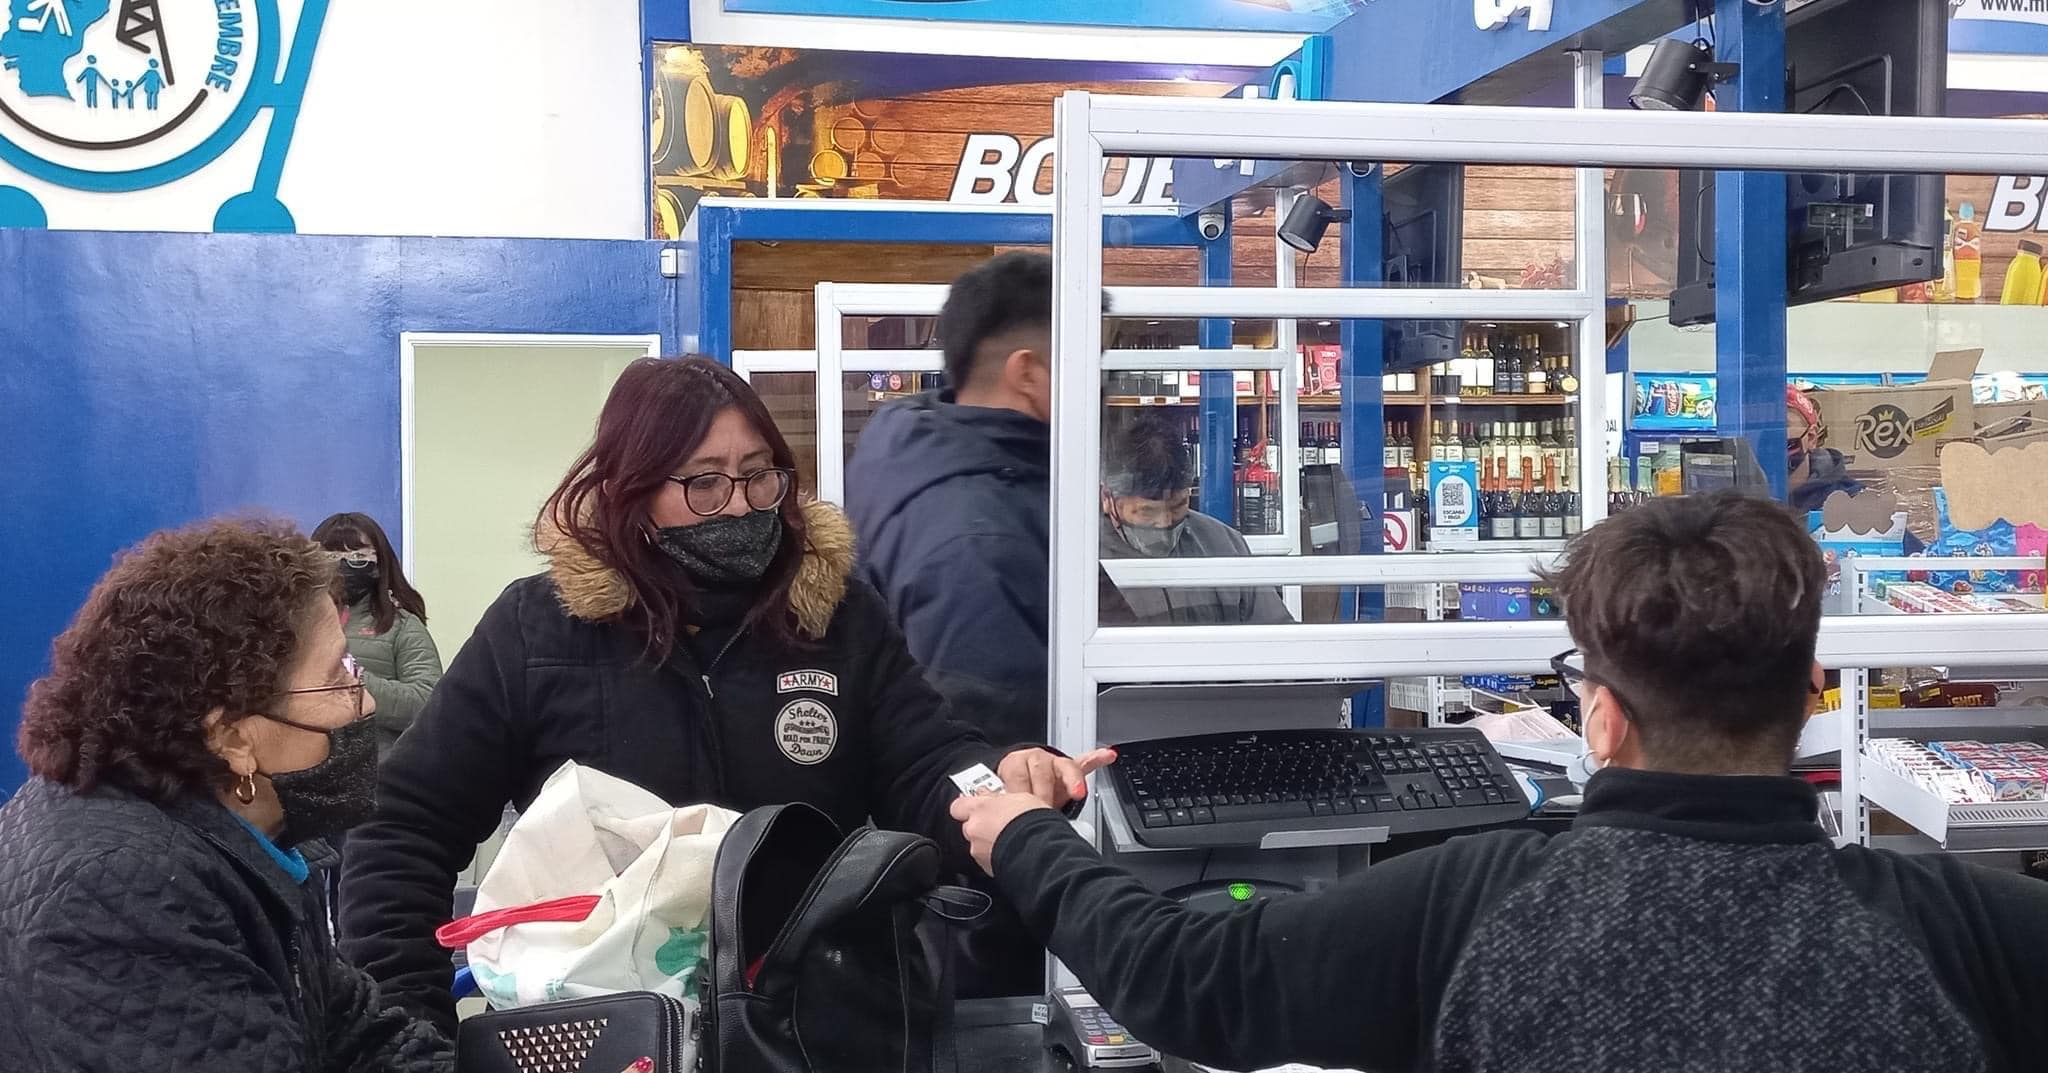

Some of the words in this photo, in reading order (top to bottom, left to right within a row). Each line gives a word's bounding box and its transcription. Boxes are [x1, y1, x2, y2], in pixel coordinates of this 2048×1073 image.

[1854, 413, 1914, 451] Rex
[791, 674, 825, 688] ARMY
[788, 706, 828, 723] Shelter
